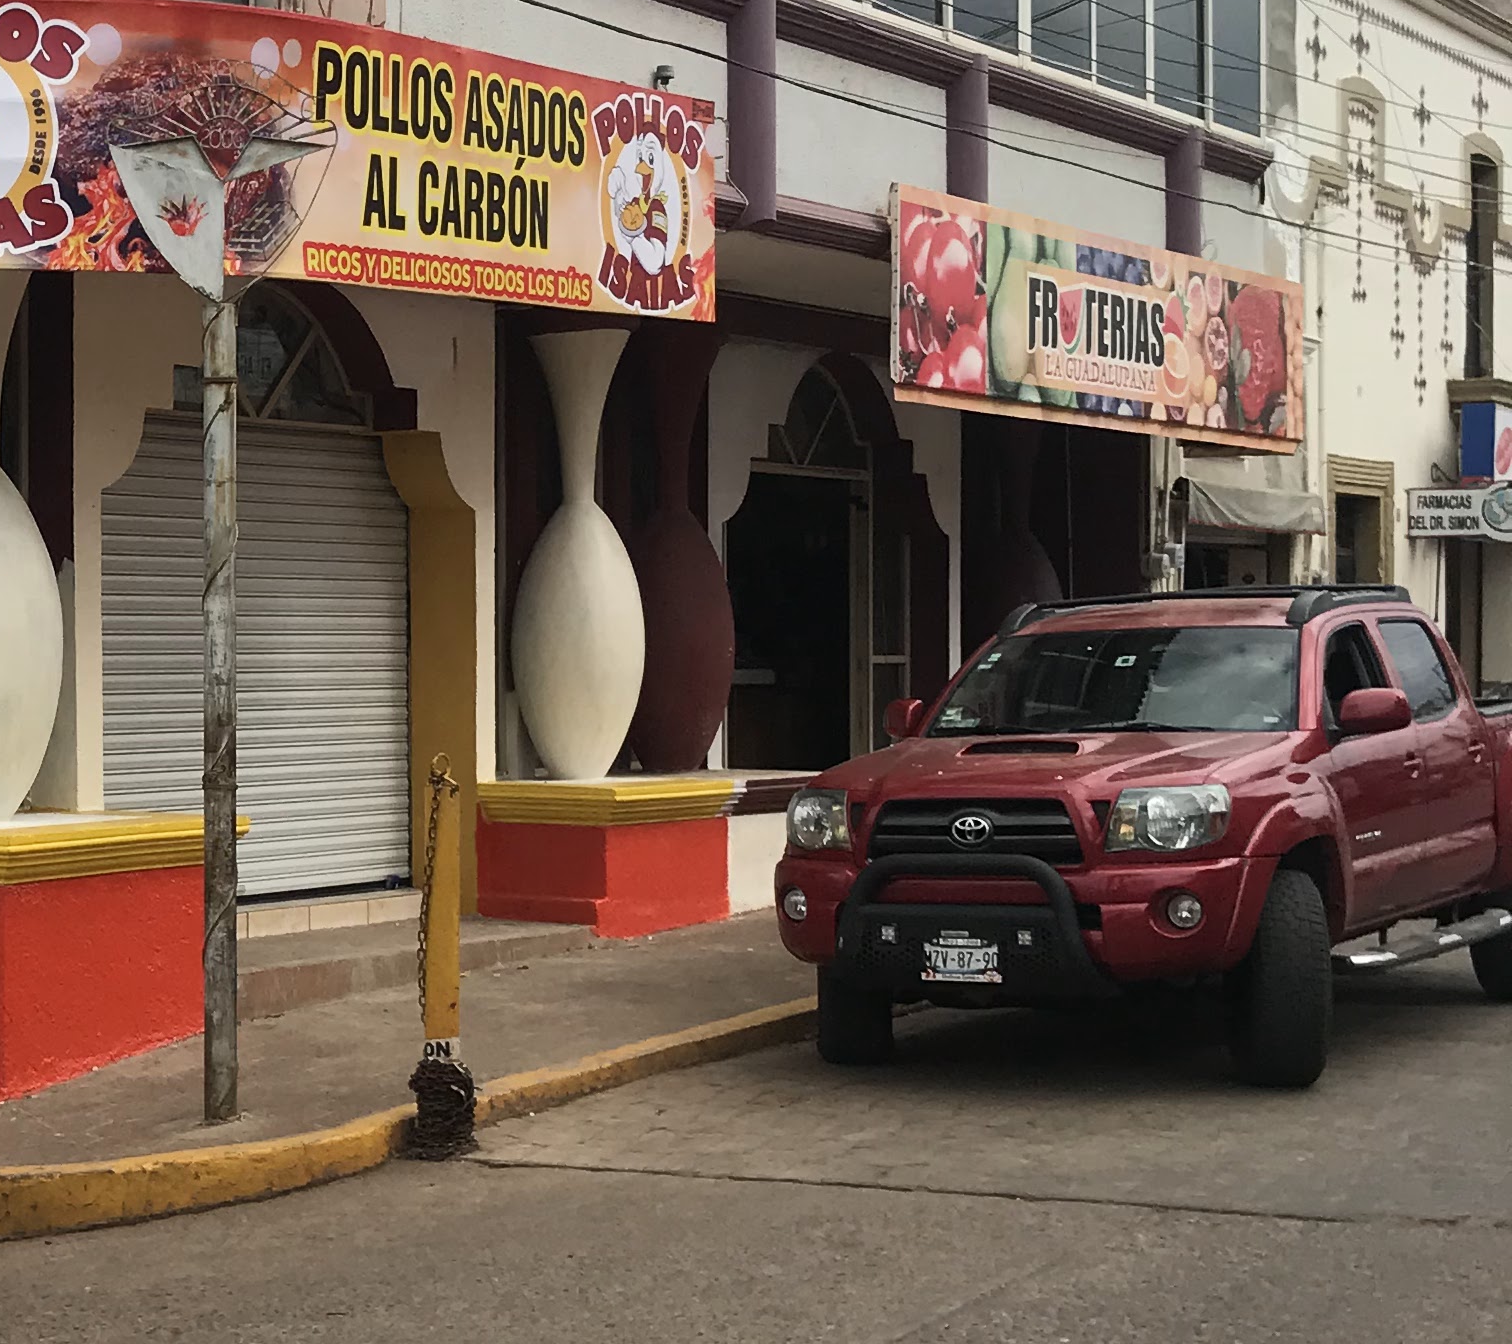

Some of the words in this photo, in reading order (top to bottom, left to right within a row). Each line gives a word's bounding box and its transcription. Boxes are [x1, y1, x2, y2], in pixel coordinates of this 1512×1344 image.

[315, 47, 453, 144] POLLOS
[463, 75, 585, 167] ASADOS
[594, 96, 703, 170] POLLOS
[28, 131, 47, 176] DESDE
[363, 153, 406, 231] AL
[417, 158, 549, 249] CARBÓN
[306, 247, 361, 277] RICOS
[364, 253, 378, 279] Y
[380, 254, 471, 288] DELICIOSOS
[474, 266, 524, 294] TODOS
[528, 270, 555, 298] LOS
[558, 267, 591, 302] DÍAS
[1028, 277, 1165, 367] FRUTERIAS
[1045, 354, 1062, 377] LA
[1066, 358, 1156, 391] GUADALUPANA
[1409, 515, 1428, 530] DEL
[1430, 515, 1446, 530] DR.
[1448, 515, 1480, 530] SIMON
[1416, 495, 1472, 510] FARMACIAS
